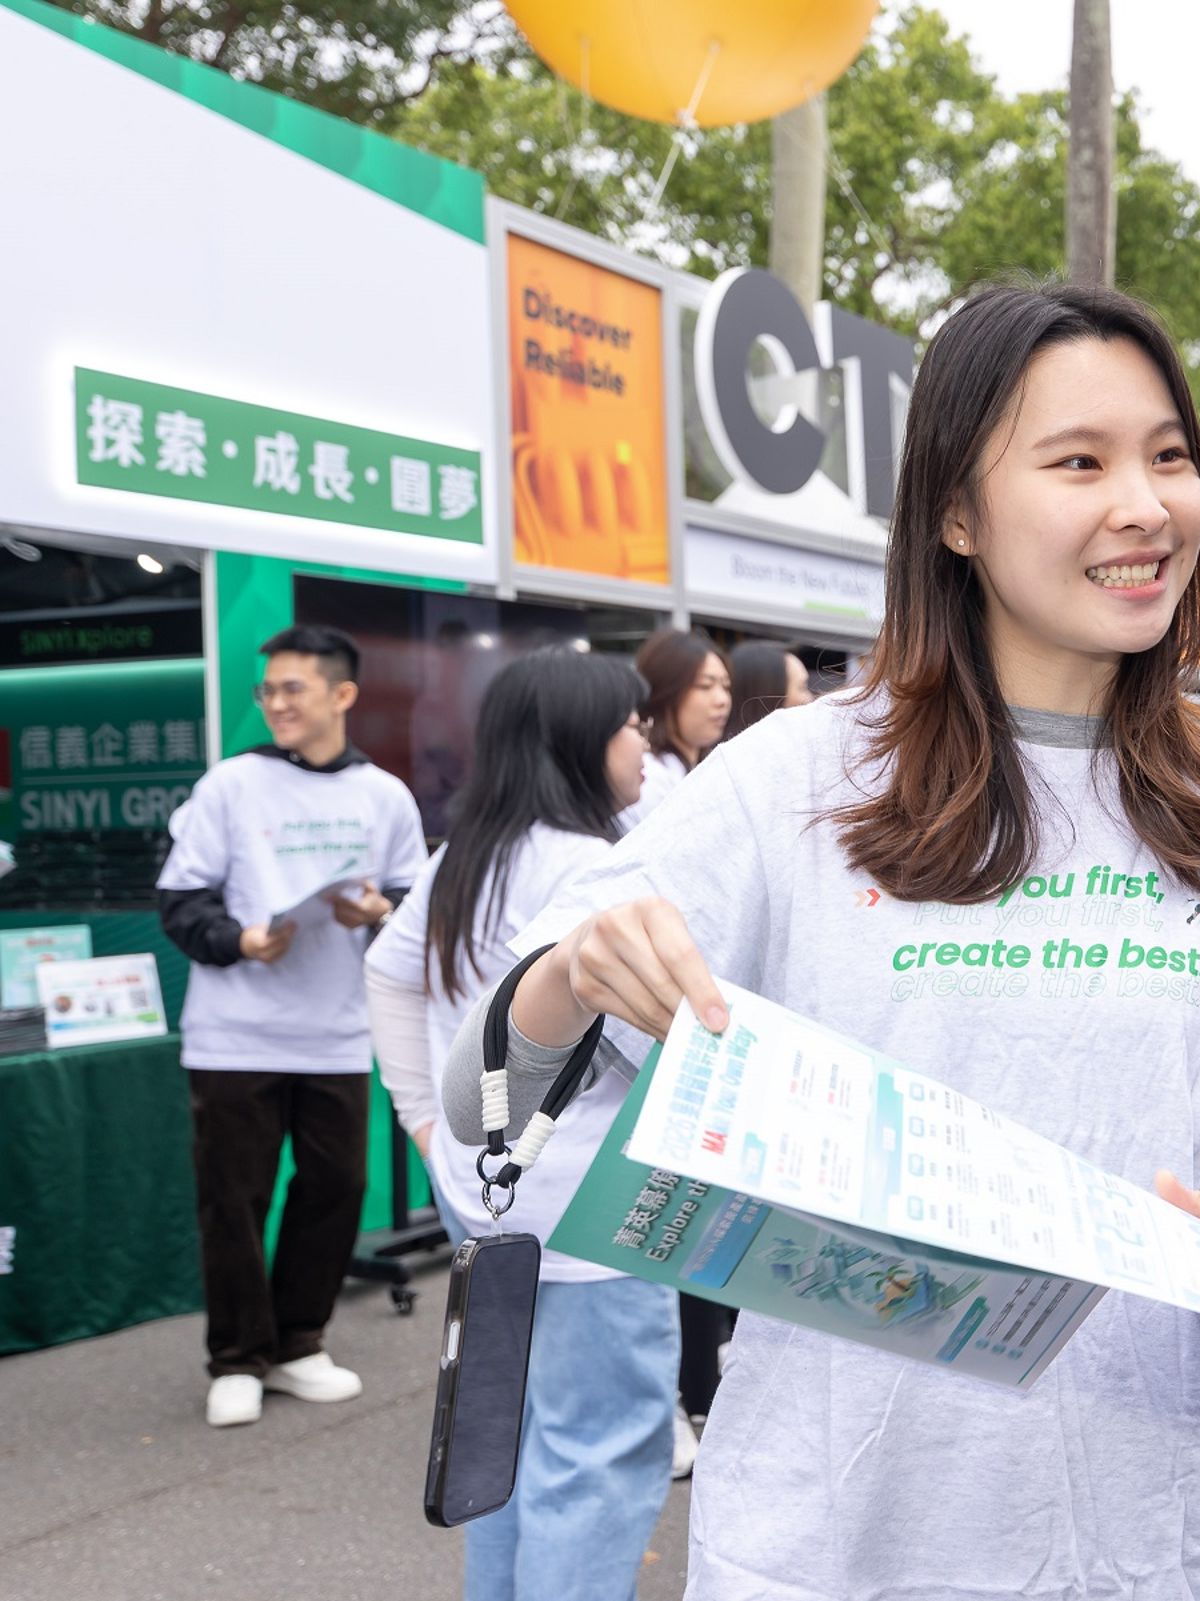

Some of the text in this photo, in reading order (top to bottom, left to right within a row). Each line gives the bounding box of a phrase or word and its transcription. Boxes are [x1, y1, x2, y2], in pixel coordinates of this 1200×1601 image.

[523, 286, 633, 349] Discover
[523, 340, 627, 397] Reliable
[19, 719, 207, 769] 信義企業集
[21, 788, 111, 831] SINYI
[1085, 865, 1165, 904] first,
[892, 939, 1031, 972] create
[1041, 938, 1108, 969] the
[645, 1199, 700, 1262] Explore
